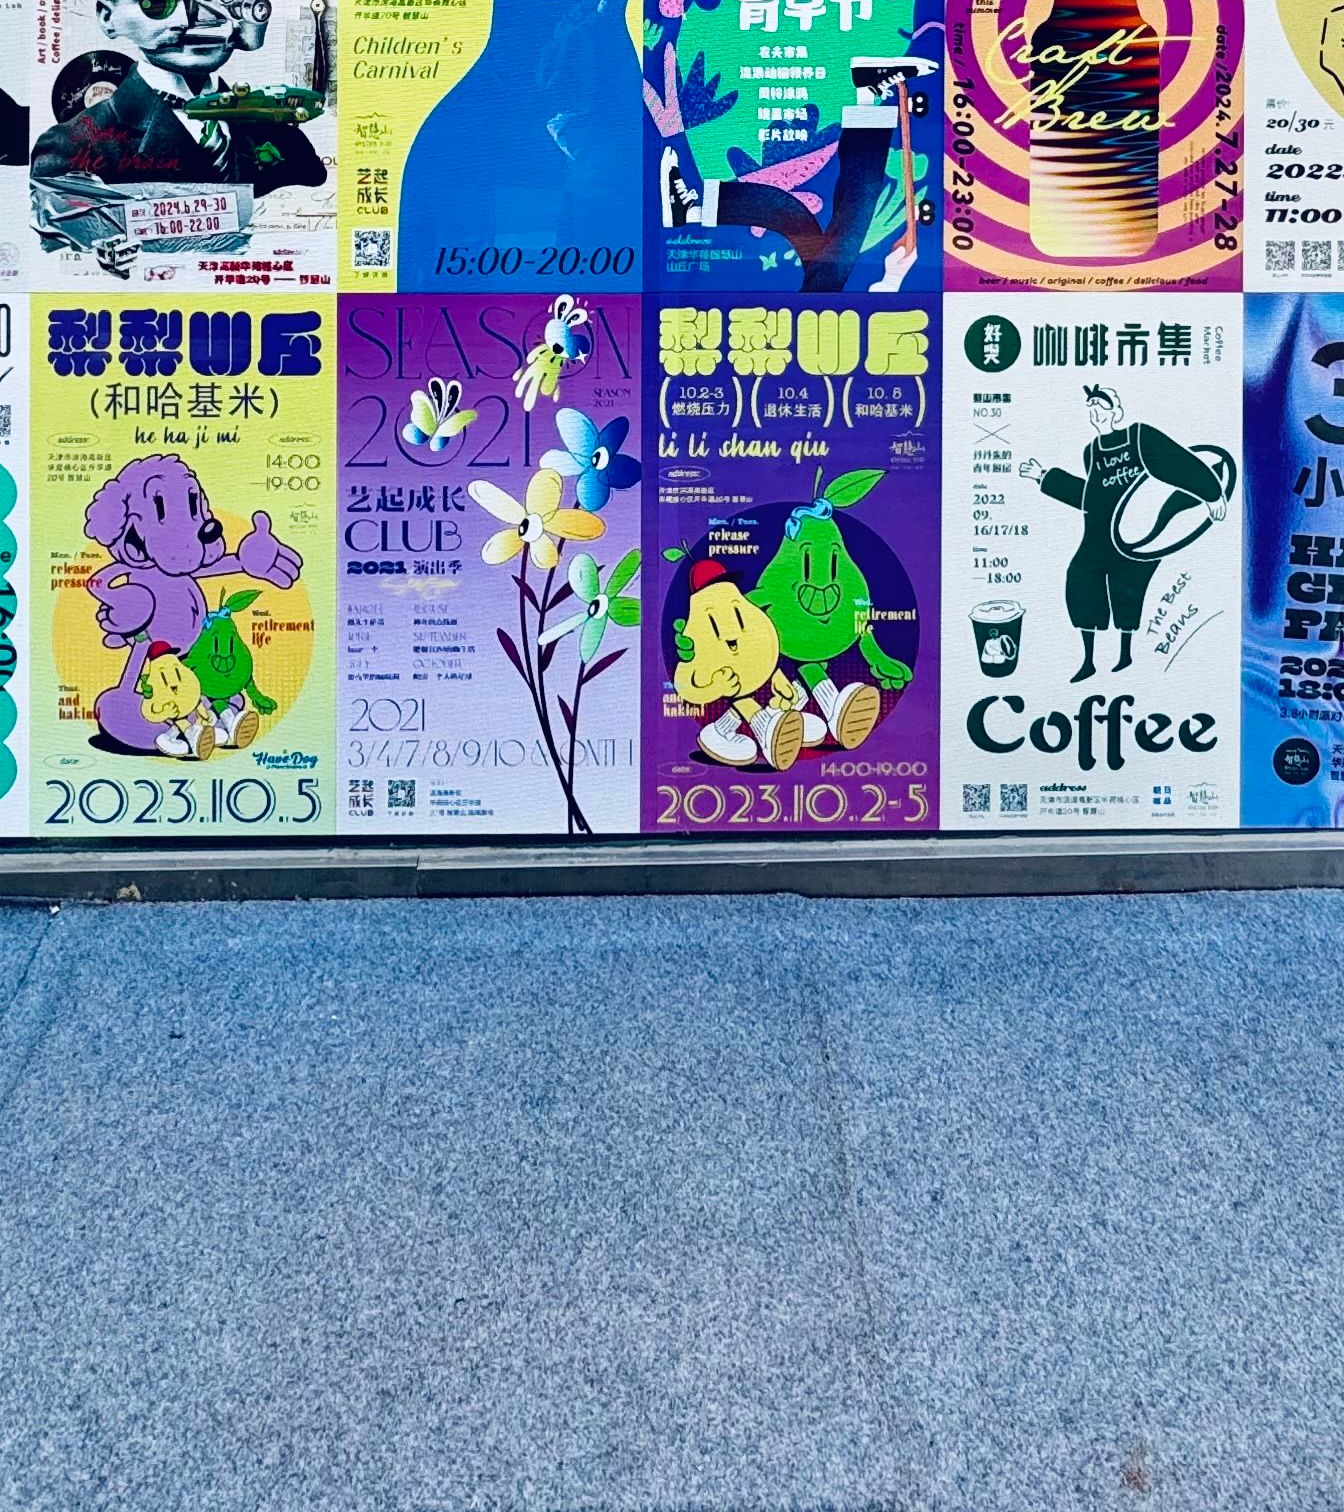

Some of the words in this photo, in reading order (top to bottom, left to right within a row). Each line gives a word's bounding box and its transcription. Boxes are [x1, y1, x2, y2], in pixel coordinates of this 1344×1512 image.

[354, 61, 439, 80] Carnival
[1266, 111, 1320, 133] 20/30
[1265, 144, 1302, 157] date
[953, 79, 974, 250] 16:00-23:00
[1265, 191, 1301, 203] time
[357, 206, 388, 215] CLUB
[435, 246, 634, 276] 15:00-20:00
[1033, 323, 1192, 366] 咖啡市集
[778, 388, 809, 400] 10.4
[764, 403, 822, 418] 退休生活
[347, 486, 465, 512] 艺起成长
[973, 494, 1005, 505] 2022
[345, 520, 462, 553] CLUB
[973, 524, 1029, 537] 16/17/18
[709, 543, 759, 556] pressure
[51, 564, 92, 575] release
[347, 562, 407, 574] 2021
[413, 562, 462, 575] 演出季
[252, 620, 314, 632] retirement
[967, 695, 1217, 771] Coffee
[45, 779, 321, 823] 2023.10.5
[657, 785, 927, 823] 2023.10.2-5
